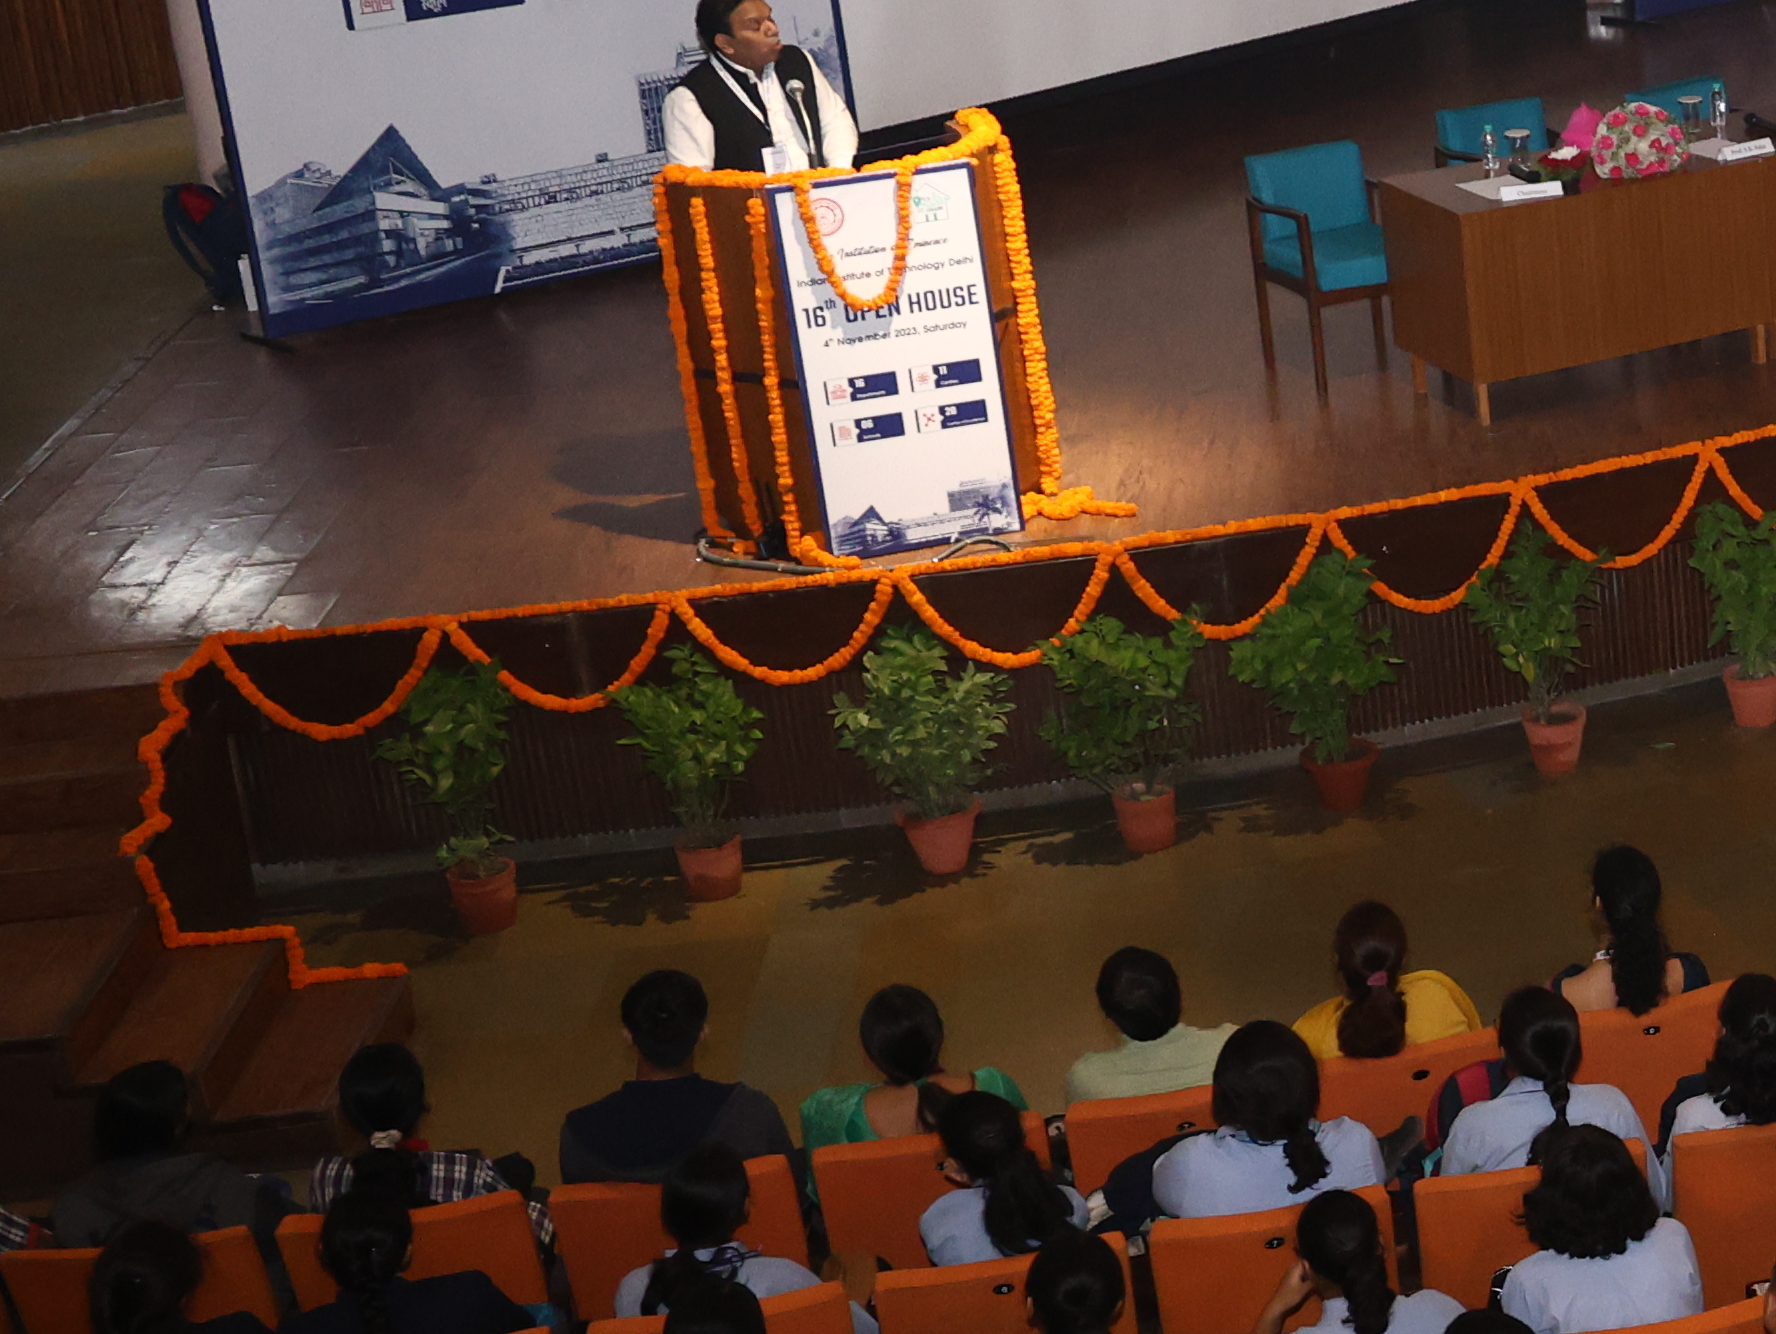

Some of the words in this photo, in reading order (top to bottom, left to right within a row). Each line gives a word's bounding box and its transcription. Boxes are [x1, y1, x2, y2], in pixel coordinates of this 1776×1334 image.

[907, 237, 949, 249] minence
[874, 268, 885, 279] of
[948, 255, 974, 268] Delhi
[802, 297, 838, 329] 16th
[906, 283, 980, 314] HOUSE
[837, 331, 892, 347] November
[922, 320, 968, 335] Saturday
